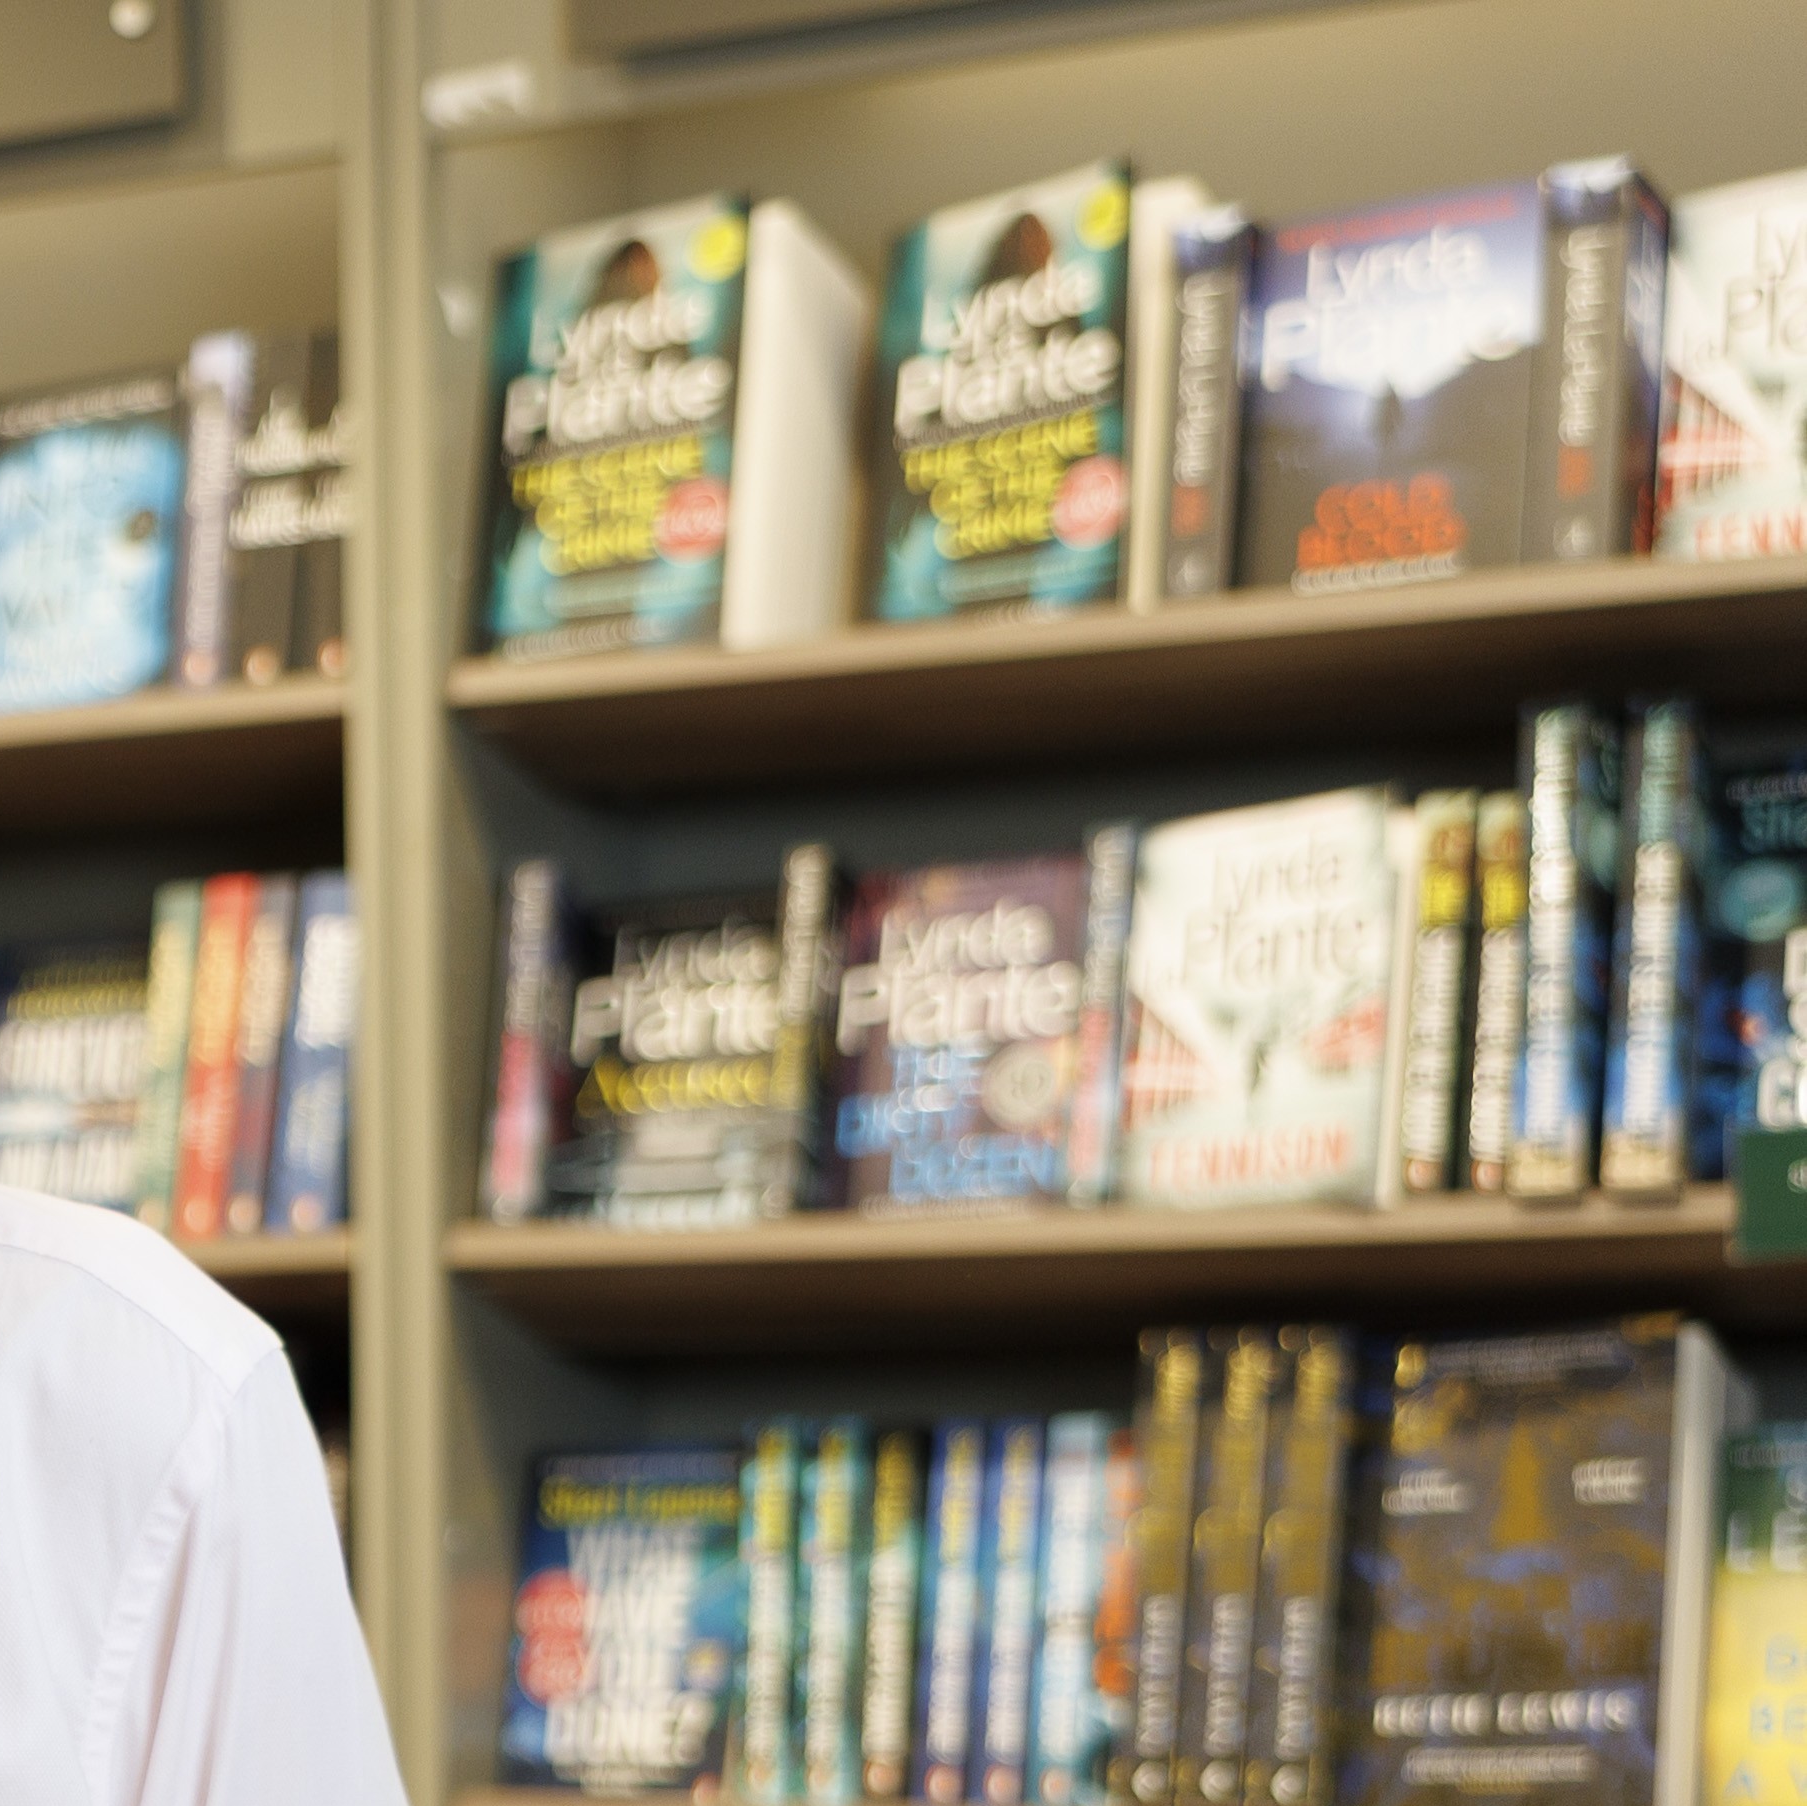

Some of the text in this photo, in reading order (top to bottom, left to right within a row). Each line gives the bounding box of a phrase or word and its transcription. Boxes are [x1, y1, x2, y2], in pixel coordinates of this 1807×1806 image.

[922, 252, 1101, 348] Lynda
[1305, 222, 1483, 303] Lynda
[532, 288, 709, 378] Lynda
[1260, 290, 1529, 394] Plante
[501, 354, 733, 456] Plante
[894, 326, 1123, 436] Plante
[1209, 828, 1341, 913] Lynda
[615, 925, 777, 994] Lynda
[879, 898, 1055, 993] Lynda
[1184, 902, 1367, 988] Plante
[835, 957, 1084, 1056] Plante
[1147, 1121, 1350, 1190] TENNISON
